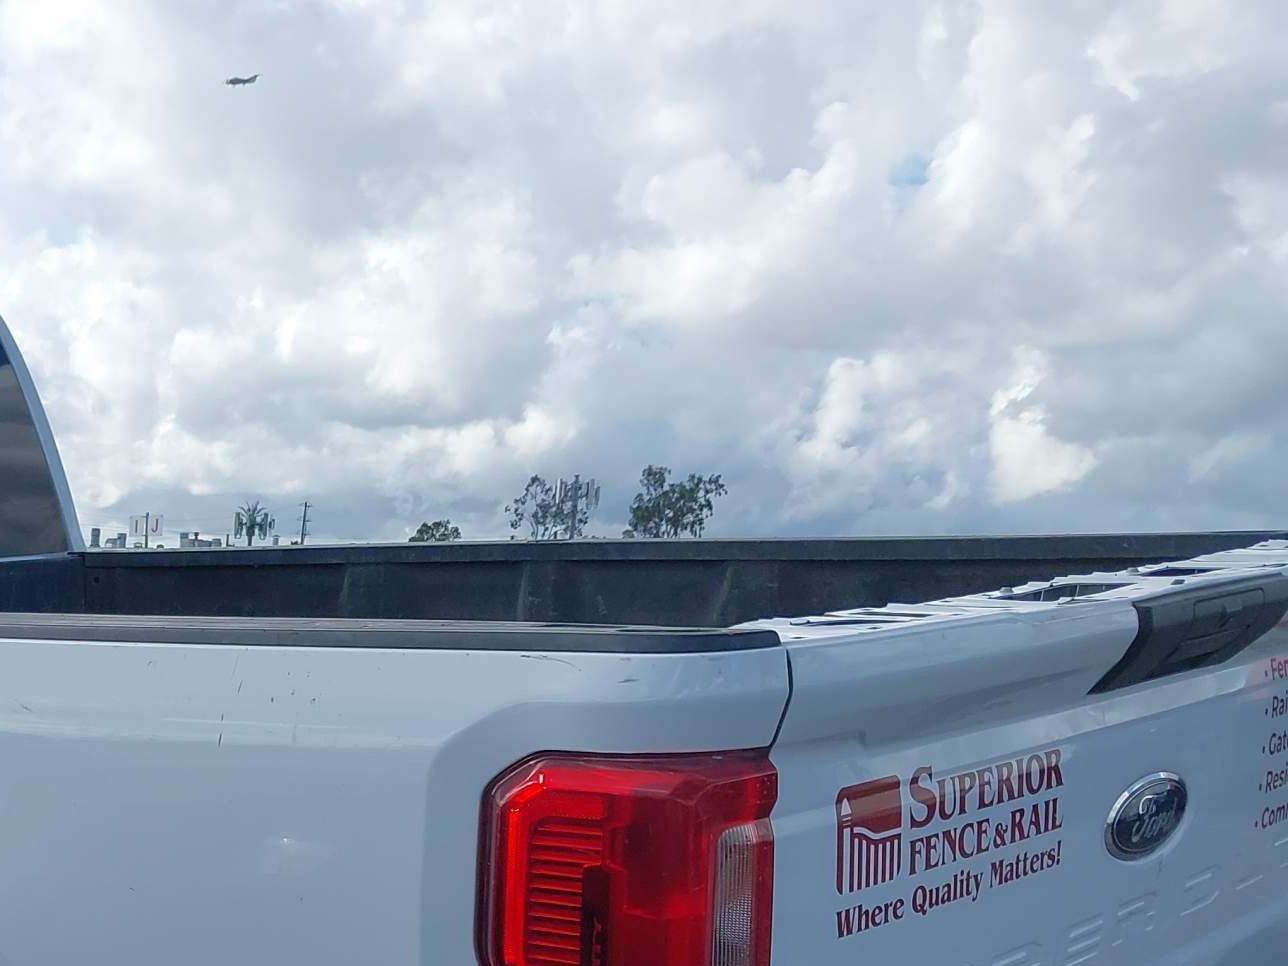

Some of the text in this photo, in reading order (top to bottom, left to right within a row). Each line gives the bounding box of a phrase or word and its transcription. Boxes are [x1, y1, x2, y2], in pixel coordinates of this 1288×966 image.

[1269, 729, 1288, 756] Gat
[909, 748, 1065, 831] SUPERIOR
[835, 839, 1063, 940] Where Quality Matters!
